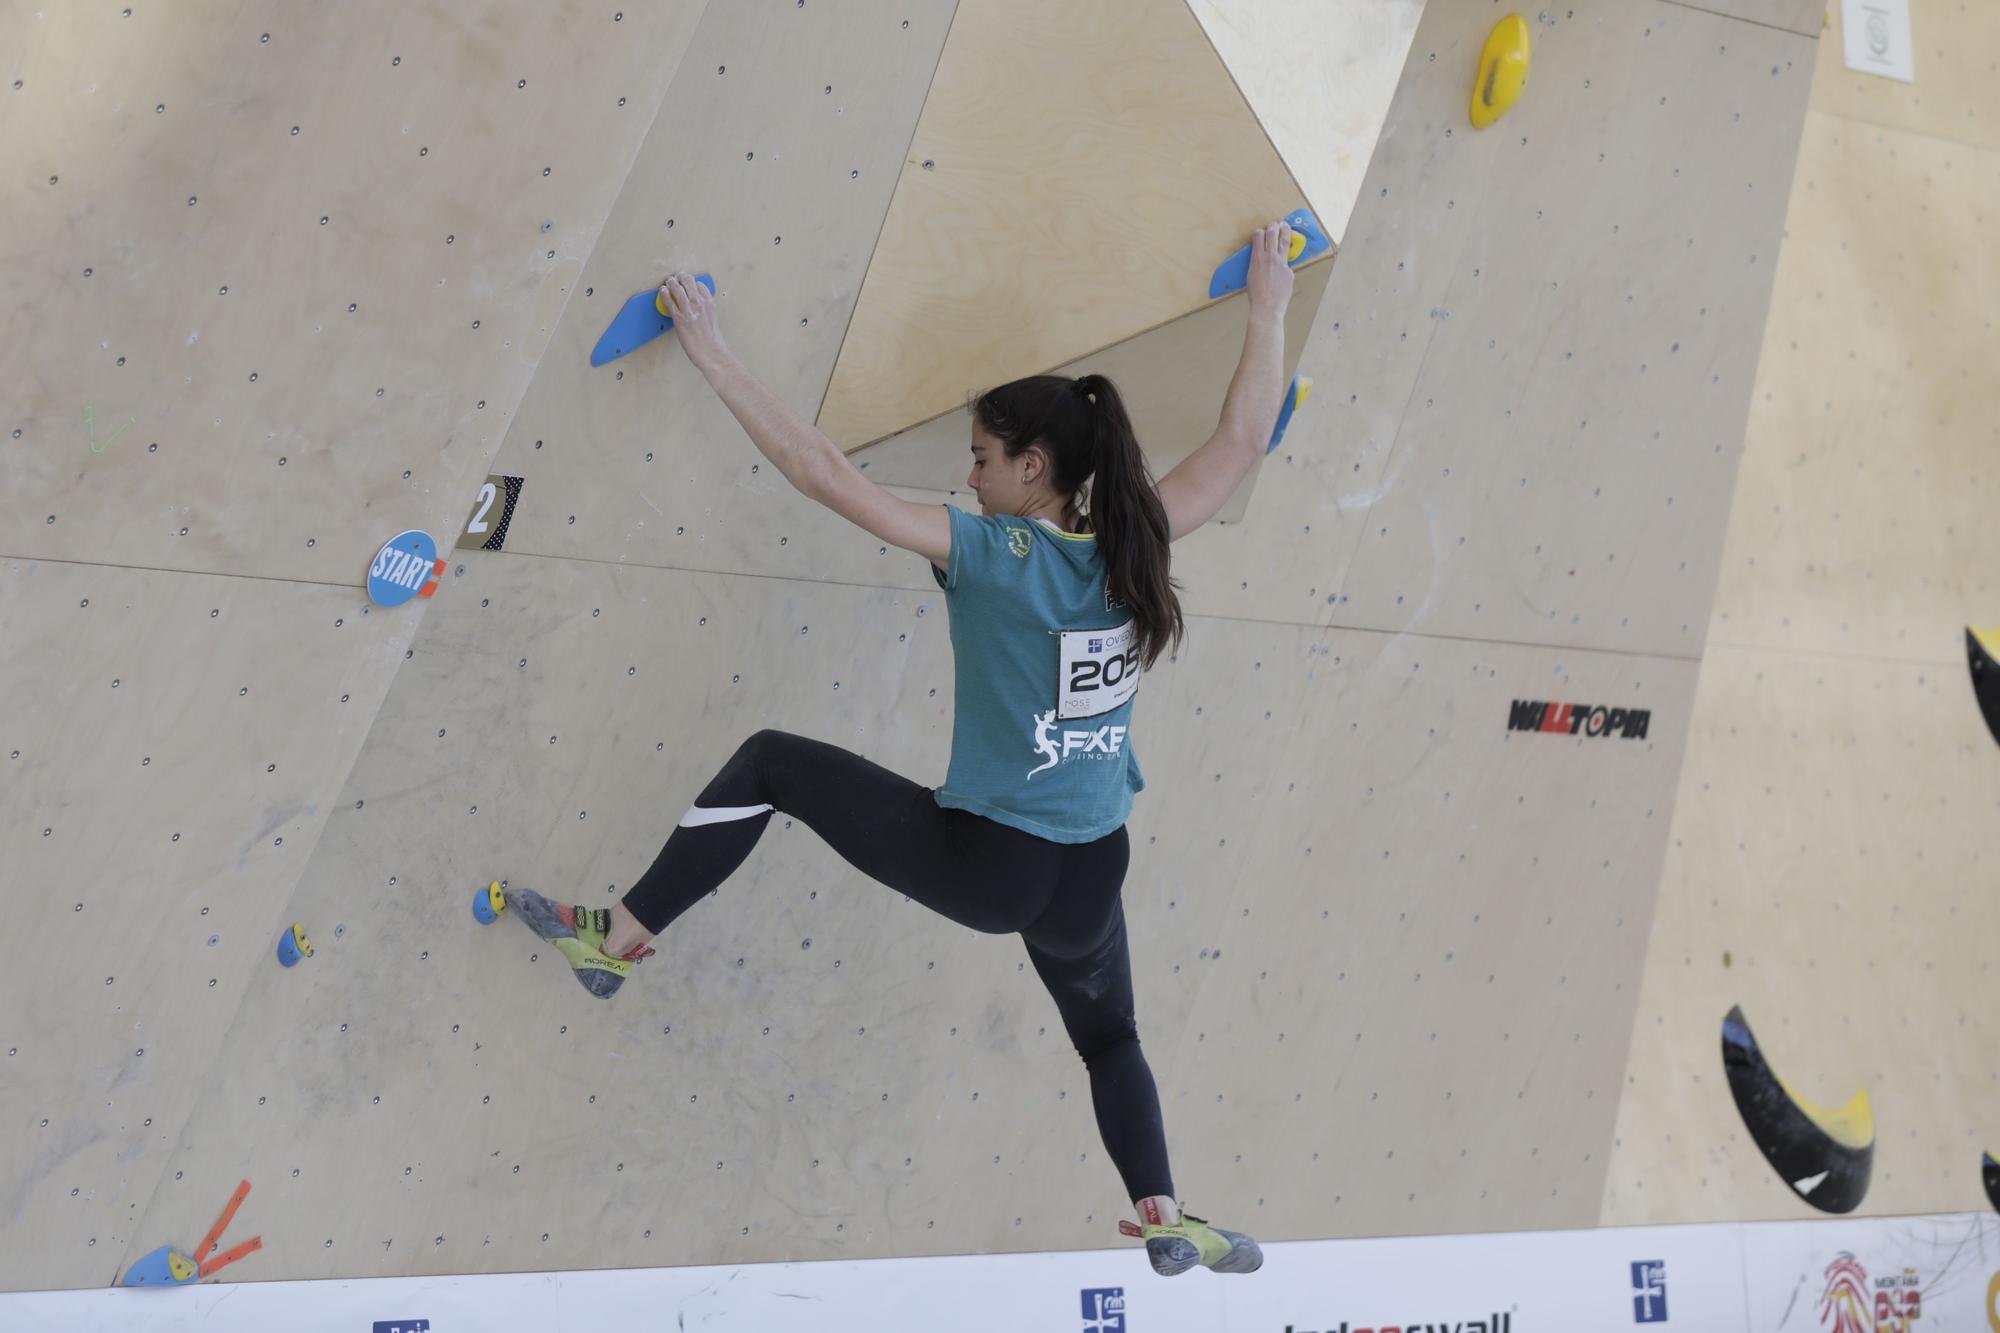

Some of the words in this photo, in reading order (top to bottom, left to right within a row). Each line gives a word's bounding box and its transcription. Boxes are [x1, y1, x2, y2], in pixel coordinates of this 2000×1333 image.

[467, 483, 497, 534] 2
[372, 546, 434, 591] START
[1070, 644, 1142, 693] 205
[1508, 699, 1652, 741] WALLTOPIA
